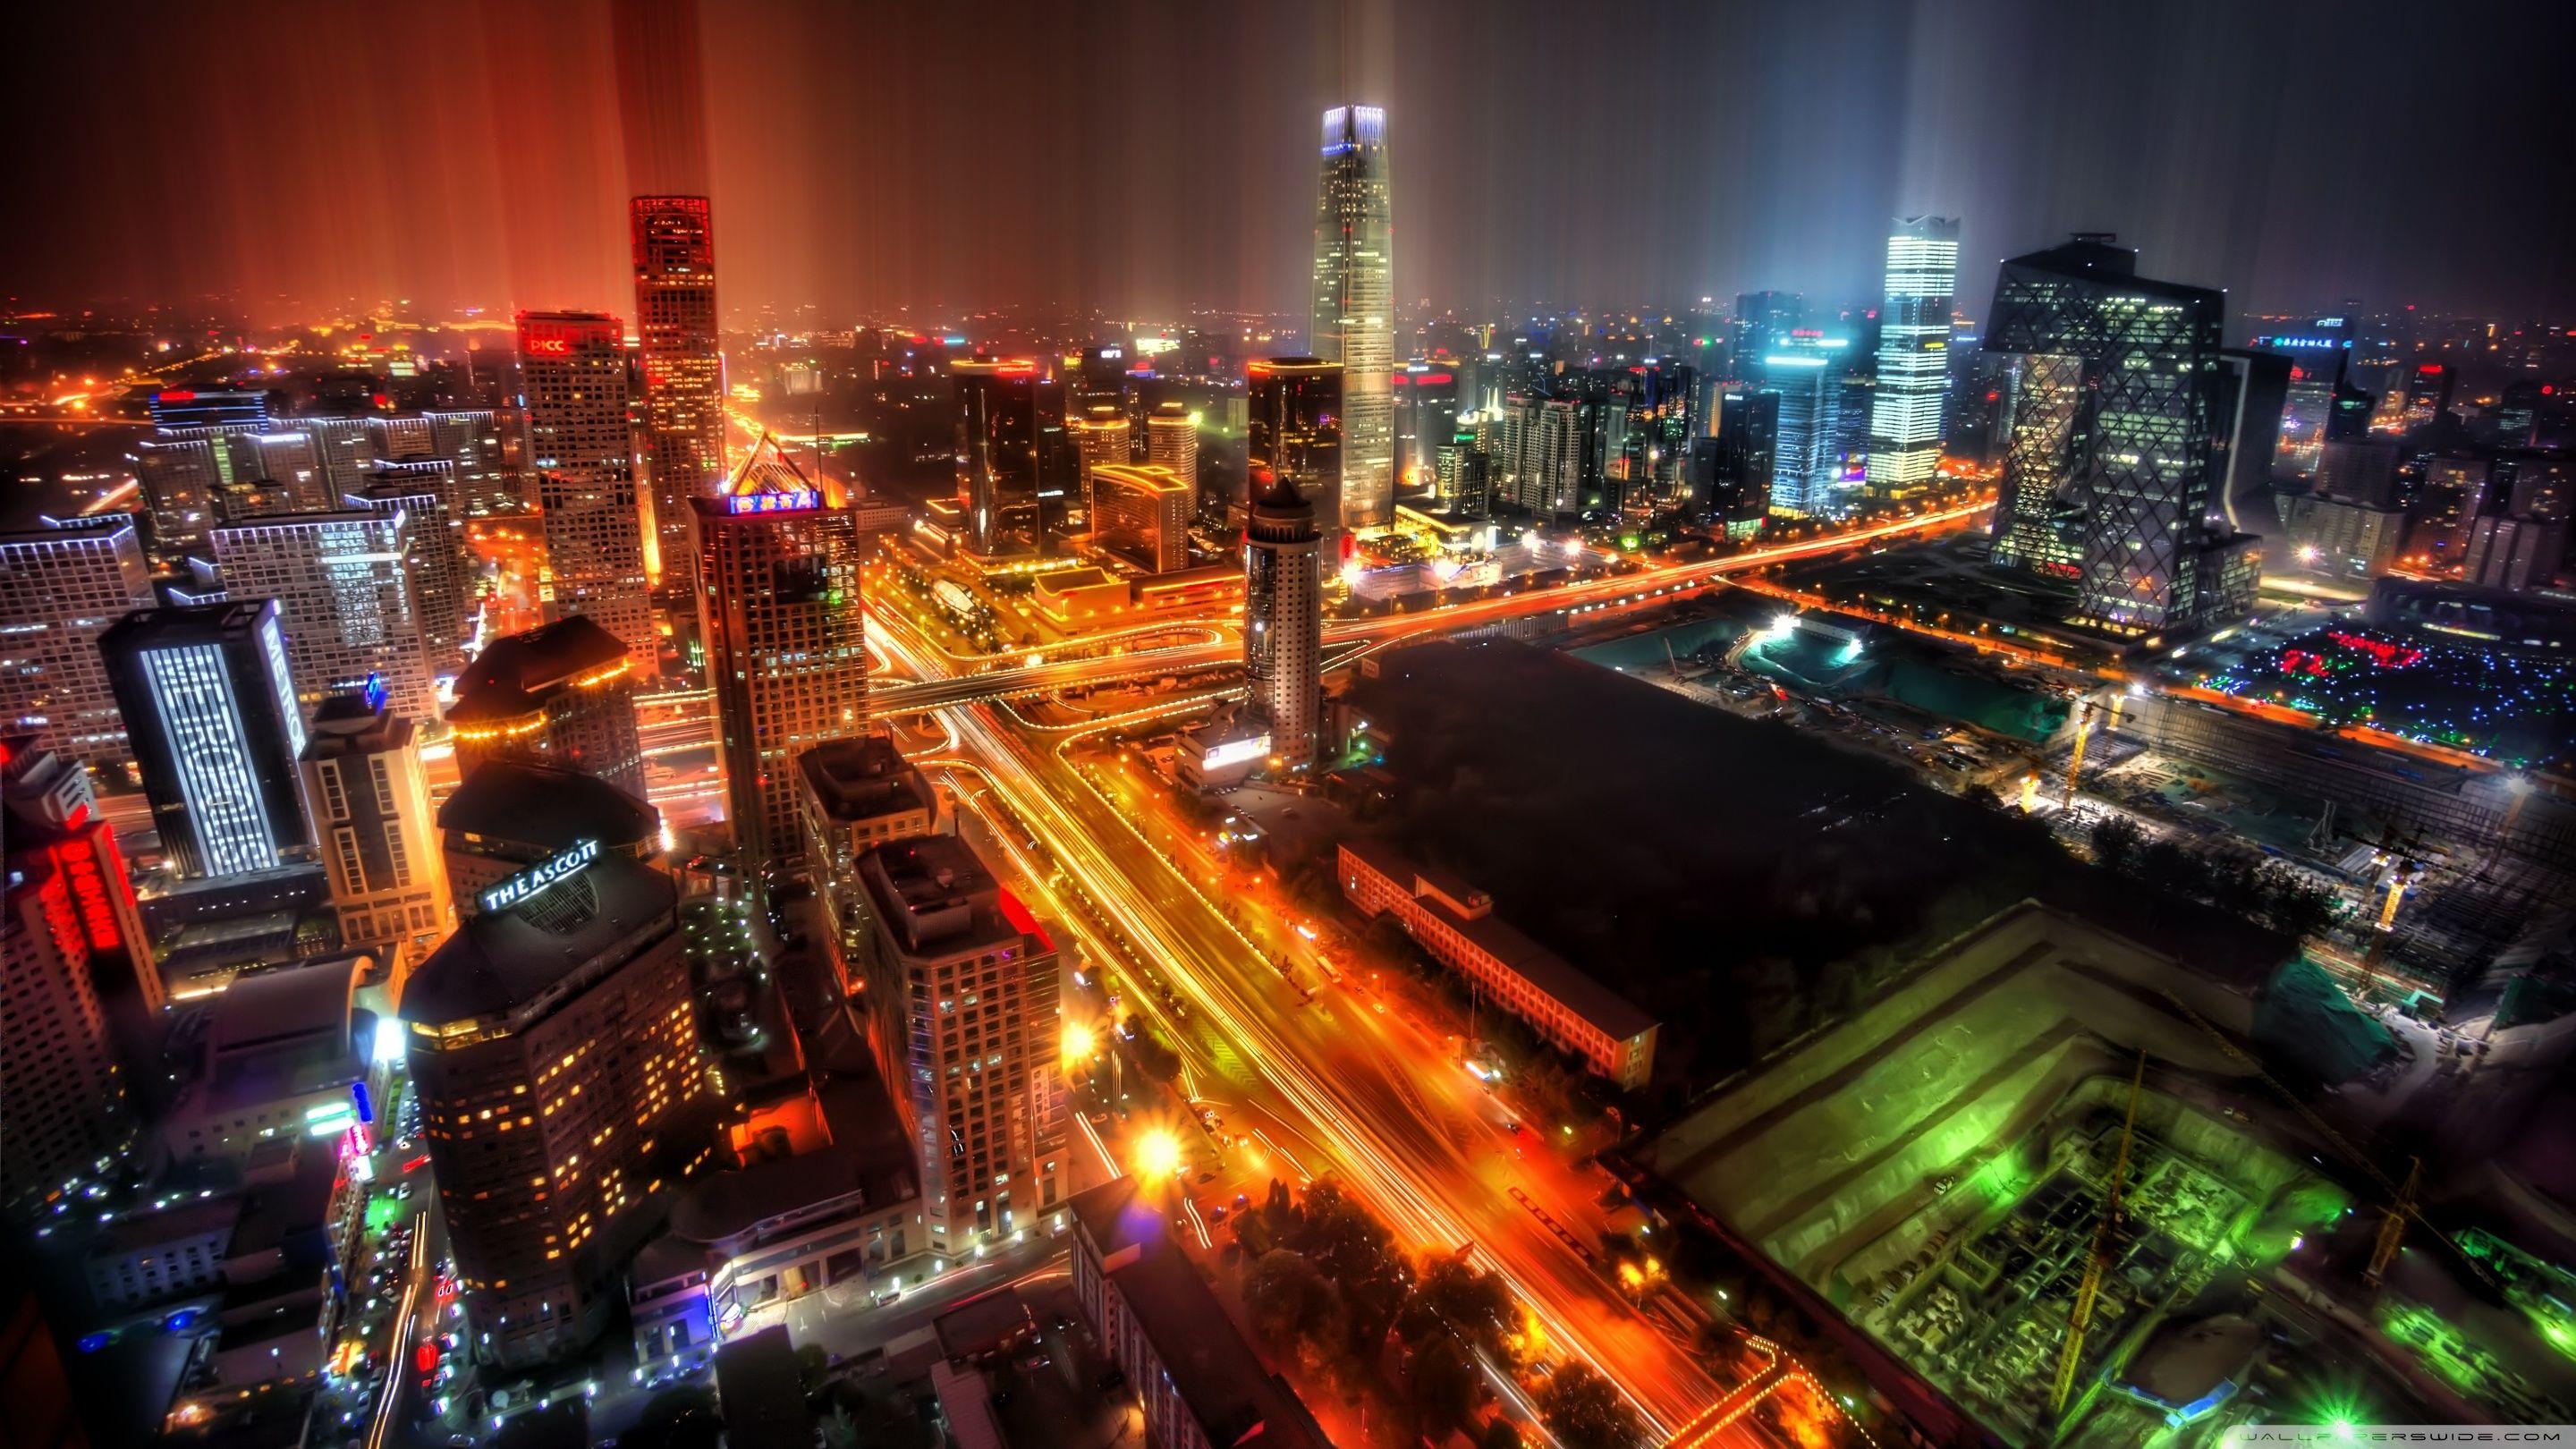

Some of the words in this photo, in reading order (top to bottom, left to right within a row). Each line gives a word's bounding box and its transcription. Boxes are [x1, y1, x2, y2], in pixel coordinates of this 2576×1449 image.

[530, 340, 564, 352] PICC
[157, 655, 267, 866] METROPOLIS
[486, 877, 529, 911] THE
[531, 840, 597, 887] ASCOTT
